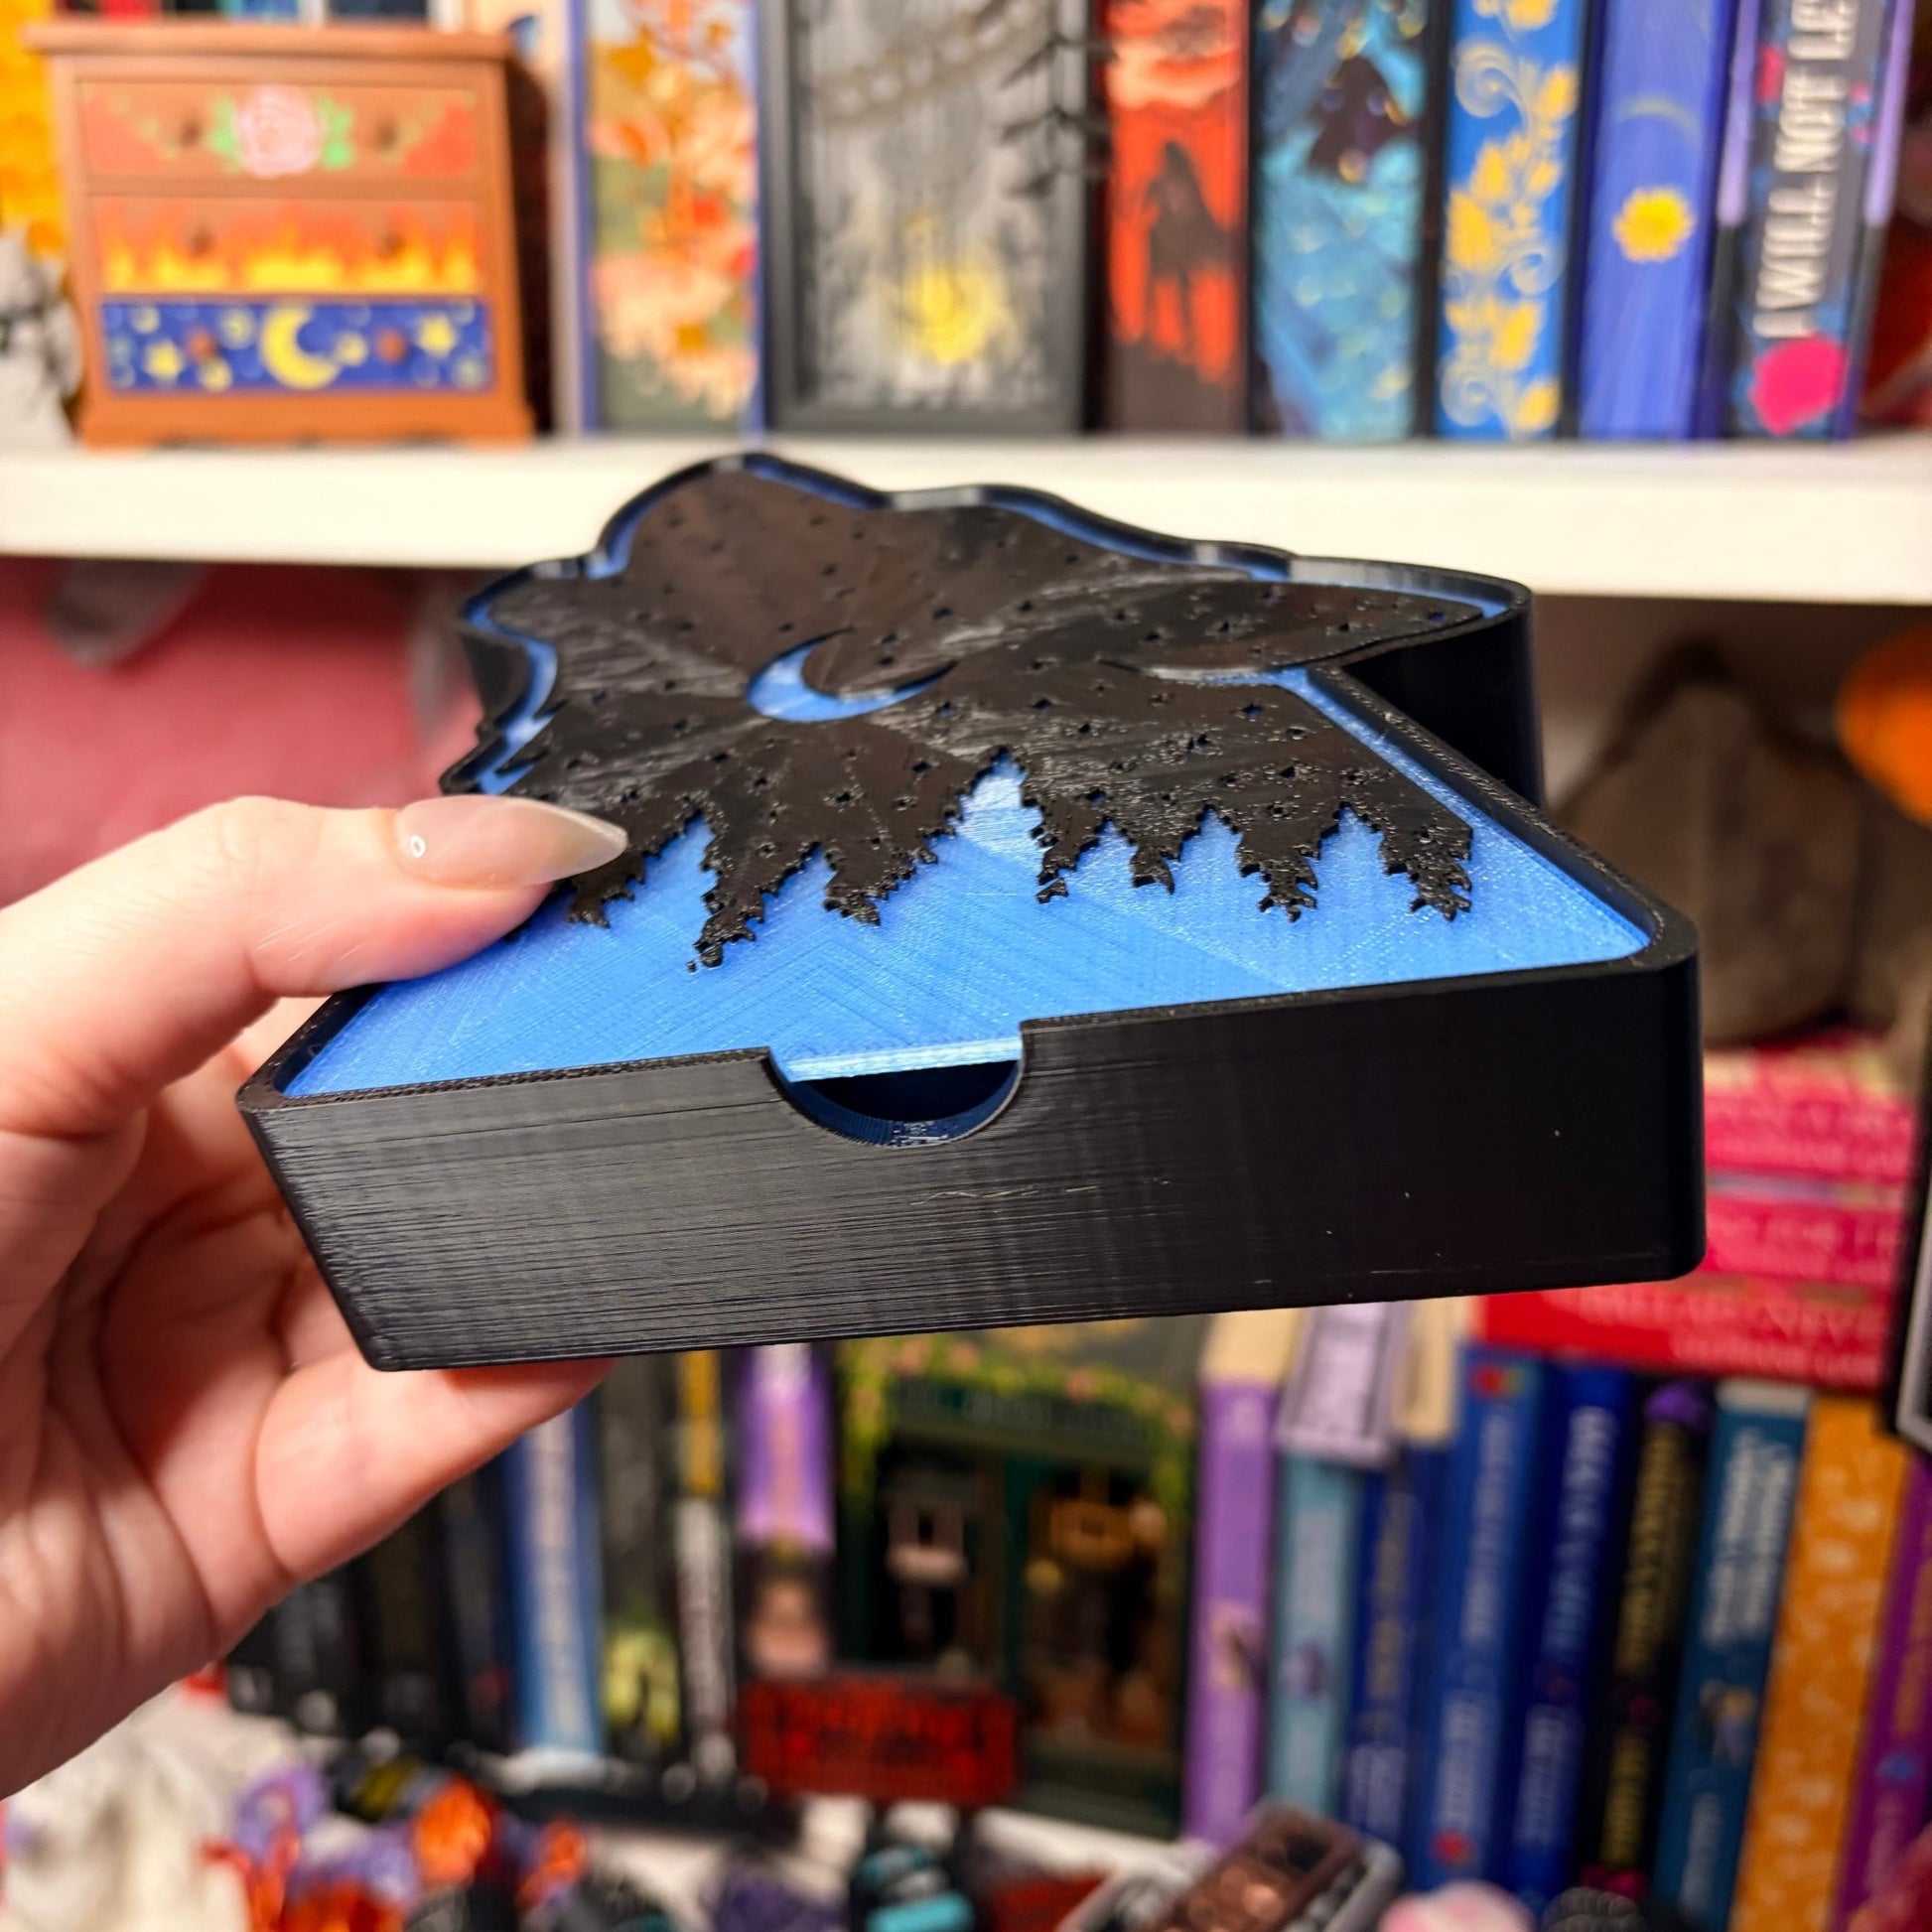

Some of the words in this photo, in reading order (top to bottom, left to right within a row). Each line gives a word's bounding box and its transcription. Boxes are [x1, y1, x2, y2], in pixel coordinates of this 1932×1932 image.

[1773, 67, 1847, 172] NOT
[1755, 175, 1837, 310] WILL
[1752, 307, 1817, 339] I
